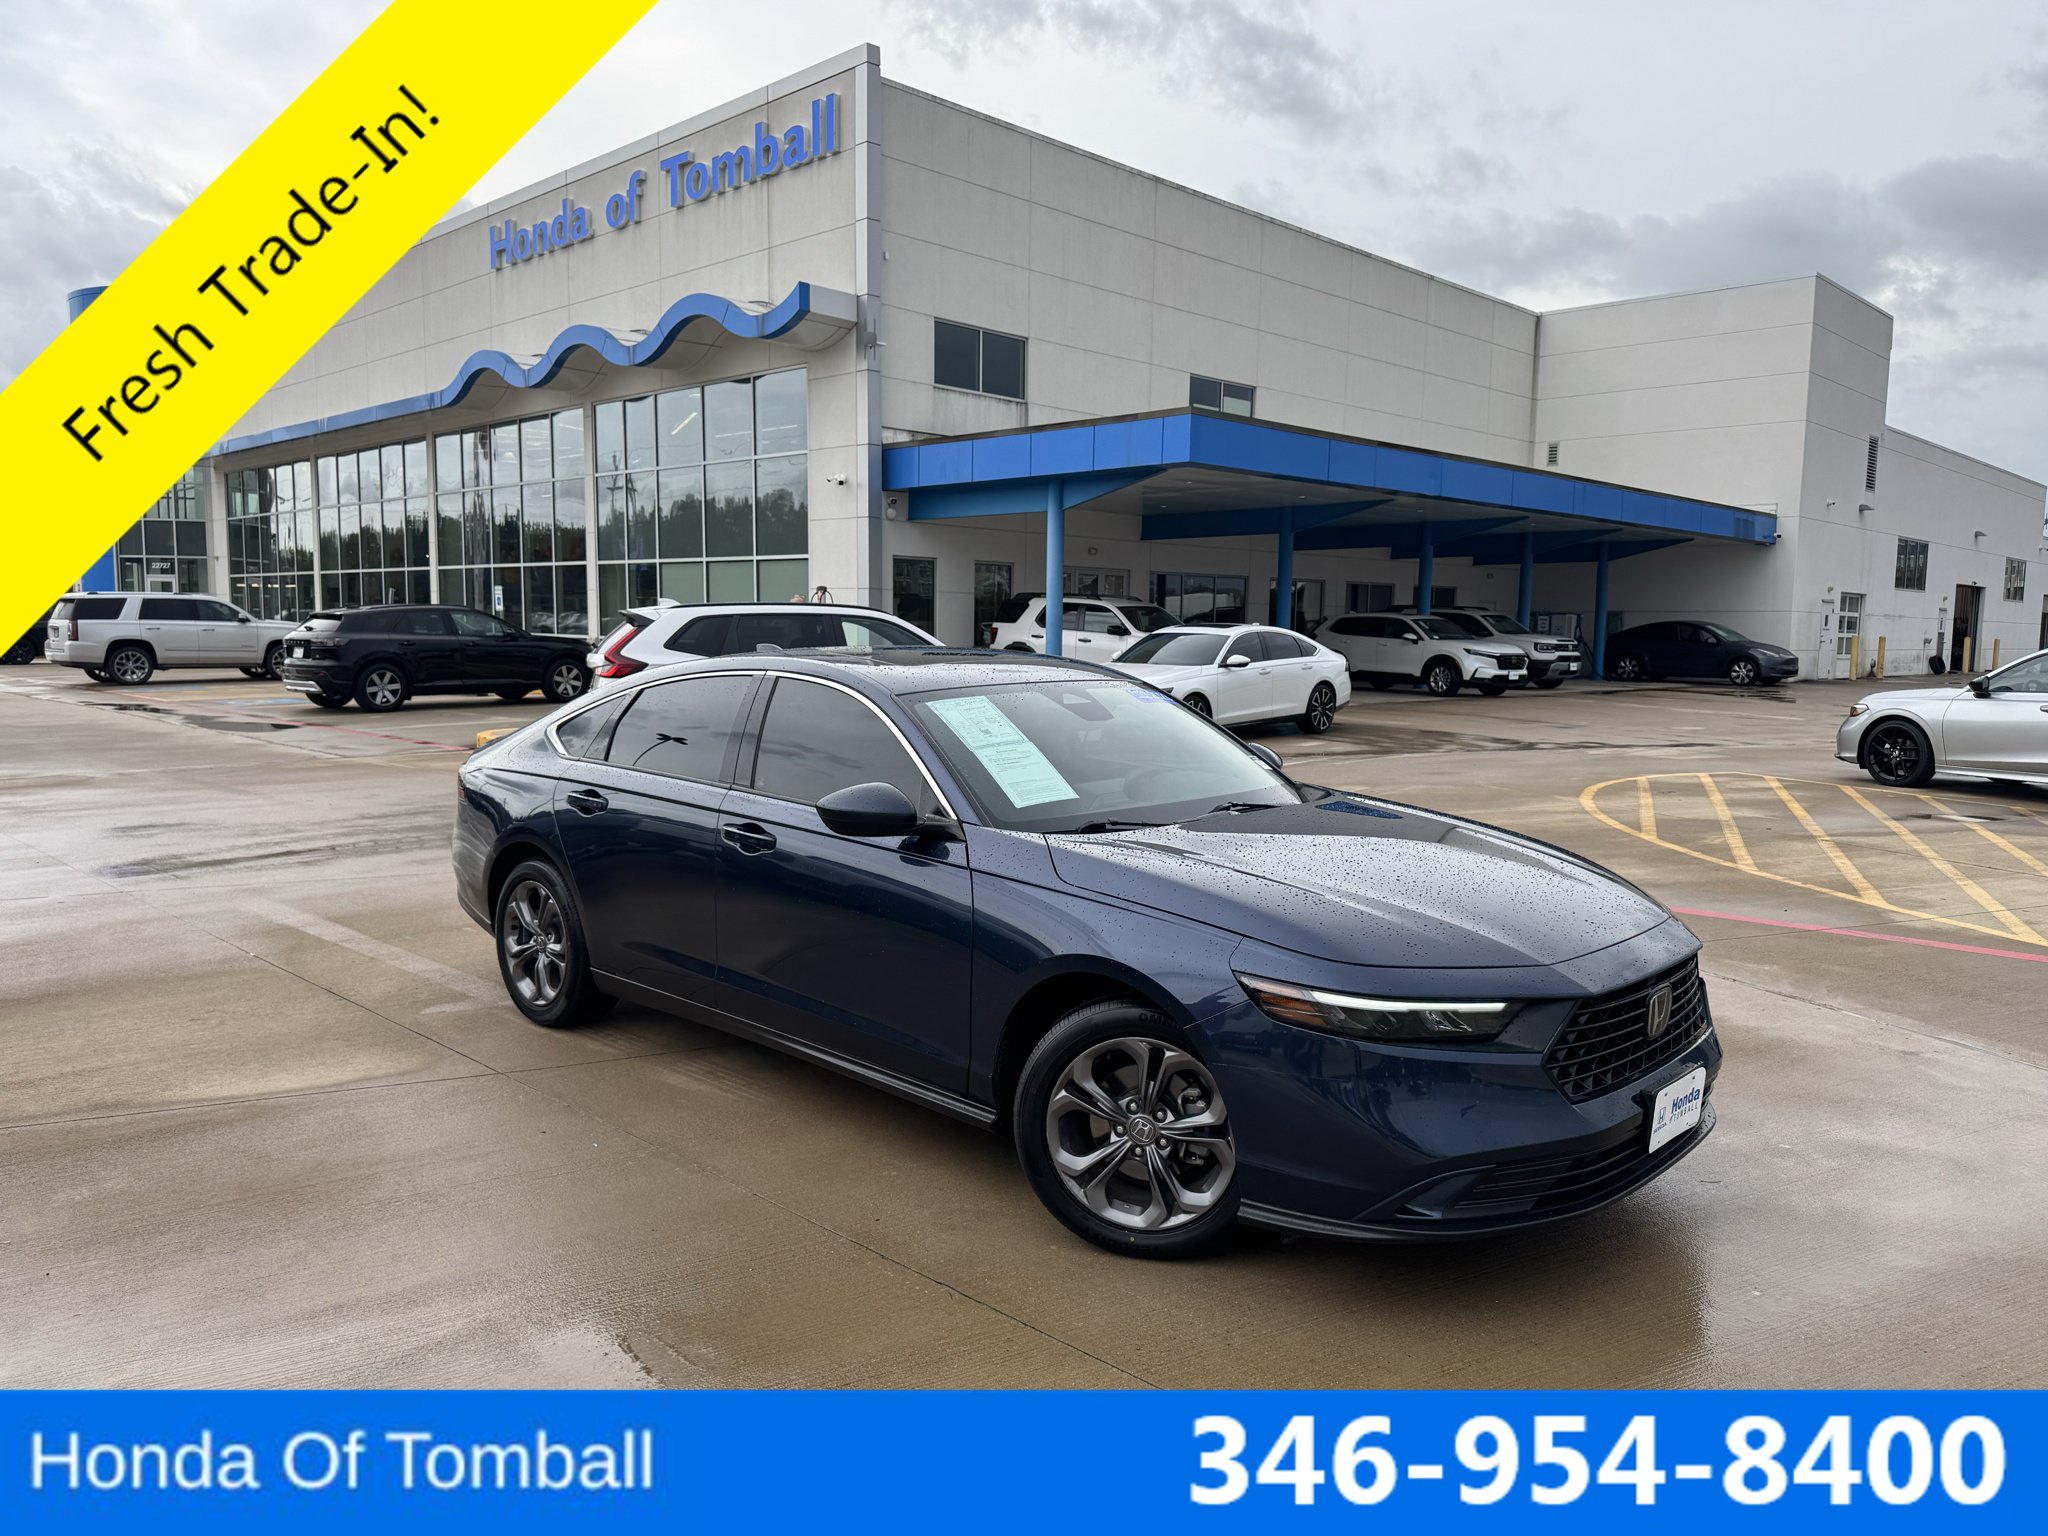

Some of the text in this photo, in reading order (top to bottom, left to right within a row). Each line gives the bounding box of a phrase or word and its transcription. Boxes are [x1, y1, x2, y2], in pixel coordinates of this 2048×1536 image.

[489, 93, 841, 270] Honda of Tomball
[1671, 1087, 1701, 1114] Honda
[1673, 1101, 1698, 1122] TOMBALL
